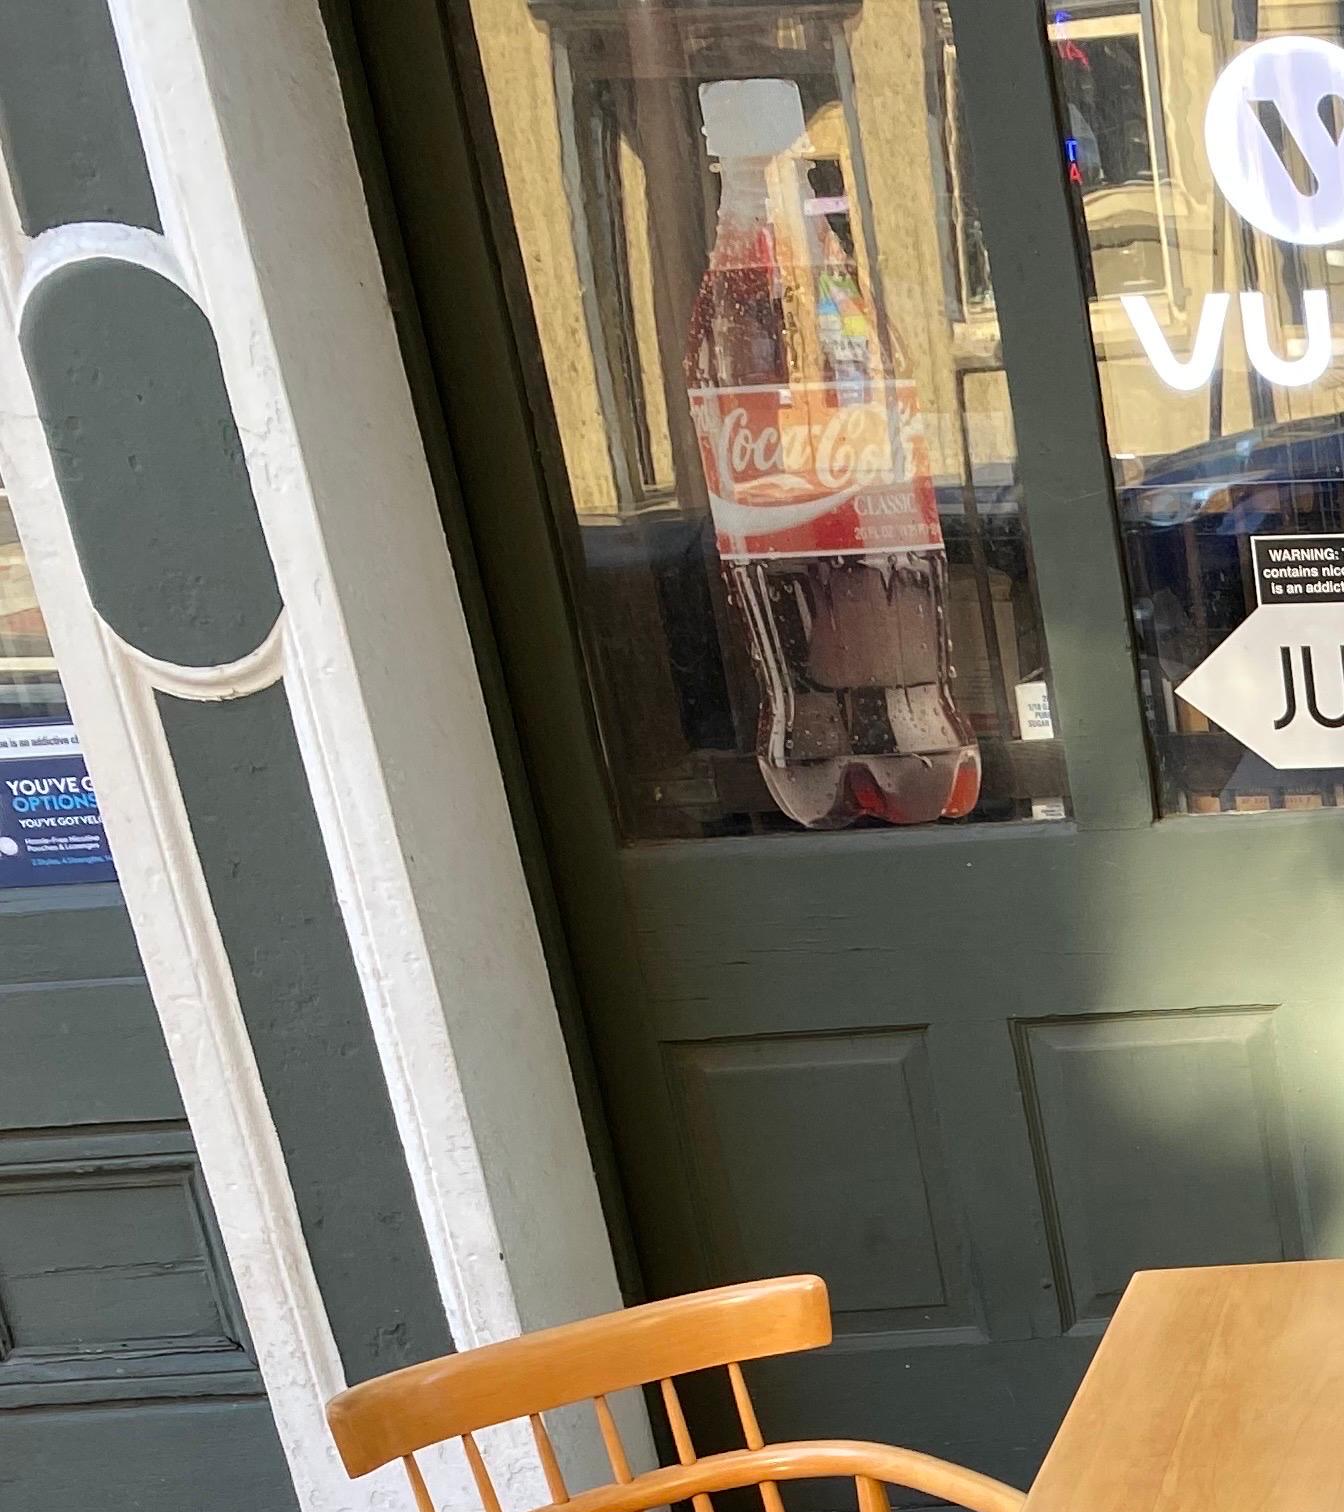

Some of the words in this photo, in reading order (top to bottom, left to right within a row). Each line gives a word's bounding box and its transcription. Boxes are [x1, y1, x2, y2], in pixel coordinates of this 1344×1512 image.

[1268, 548, 1339, 562] WARNING:
[1263, 564, 1318, 578] contains
[1270, 582, 1284, 595] is
[1286, 583, 1303, 595] an
[6, 776, 80, 796] YOU'VE
